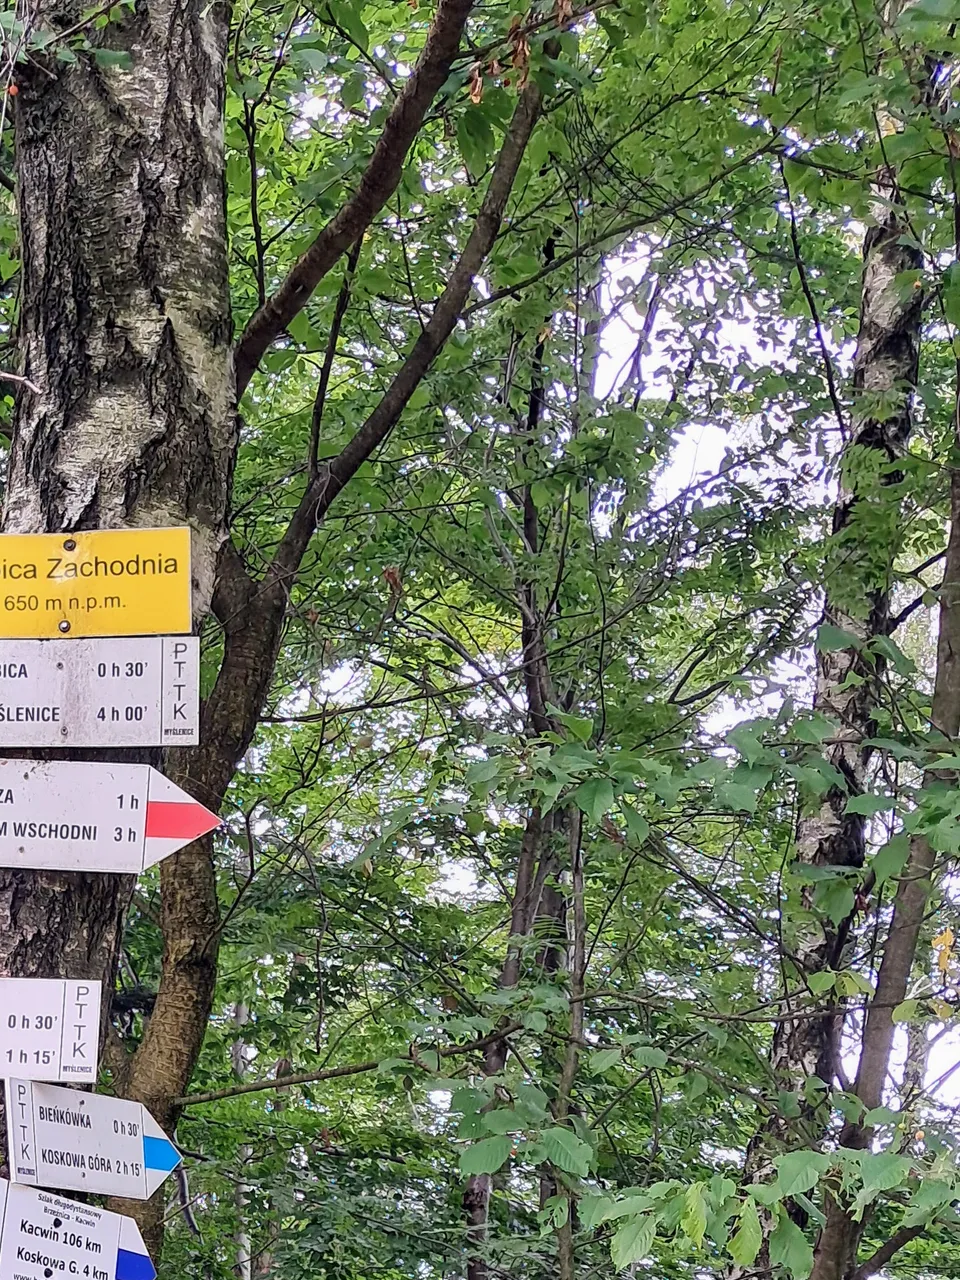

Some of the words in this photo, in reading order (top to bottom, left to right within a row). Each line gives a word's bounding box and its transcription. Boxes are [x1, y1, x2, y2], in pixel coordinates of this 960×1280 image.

[46, 554, 178, 579] Zachodnia
[4, 595, 39, 611] 650
[46, 598, 62, 610] m
[69, 597, 126, 613] n.p.m.
[111, 663, 120, 677] h
[97, 707, 106, 721] 4
[111, 707, 120, 721] h
[117, 794, 124, 809] 1
[130, 795, 139, 809] h
[13, 823, 97, 841] WSCHODNI
[114, 827, 122, 842] 3
[128, 828, 137, 843] h
[21, 1015, 30, 1029] h
[6, 1050, 12, 1064] 1
[19, 1050, 27, 1064] h
[39, 1104, 92, 1129] BIEŃKÓWKA
[42, 1148, 86, 1169] KOSKOWA
[88, 1153, 112, 1173] GÓRA
[38, 1193, 53, 1204] Szlak
[75, 1215, 96, 1228] Kacwin
[20, 1219, 59, 1242] Kacwin
[63, 1232, 82, 1248] 106
[86, 1237, 102, 1254] km
[17, 1246, 65, 1271] Koskowa
[69, 1260, 80, 1275] G.
[83, 1264, 90, 1277] 4
